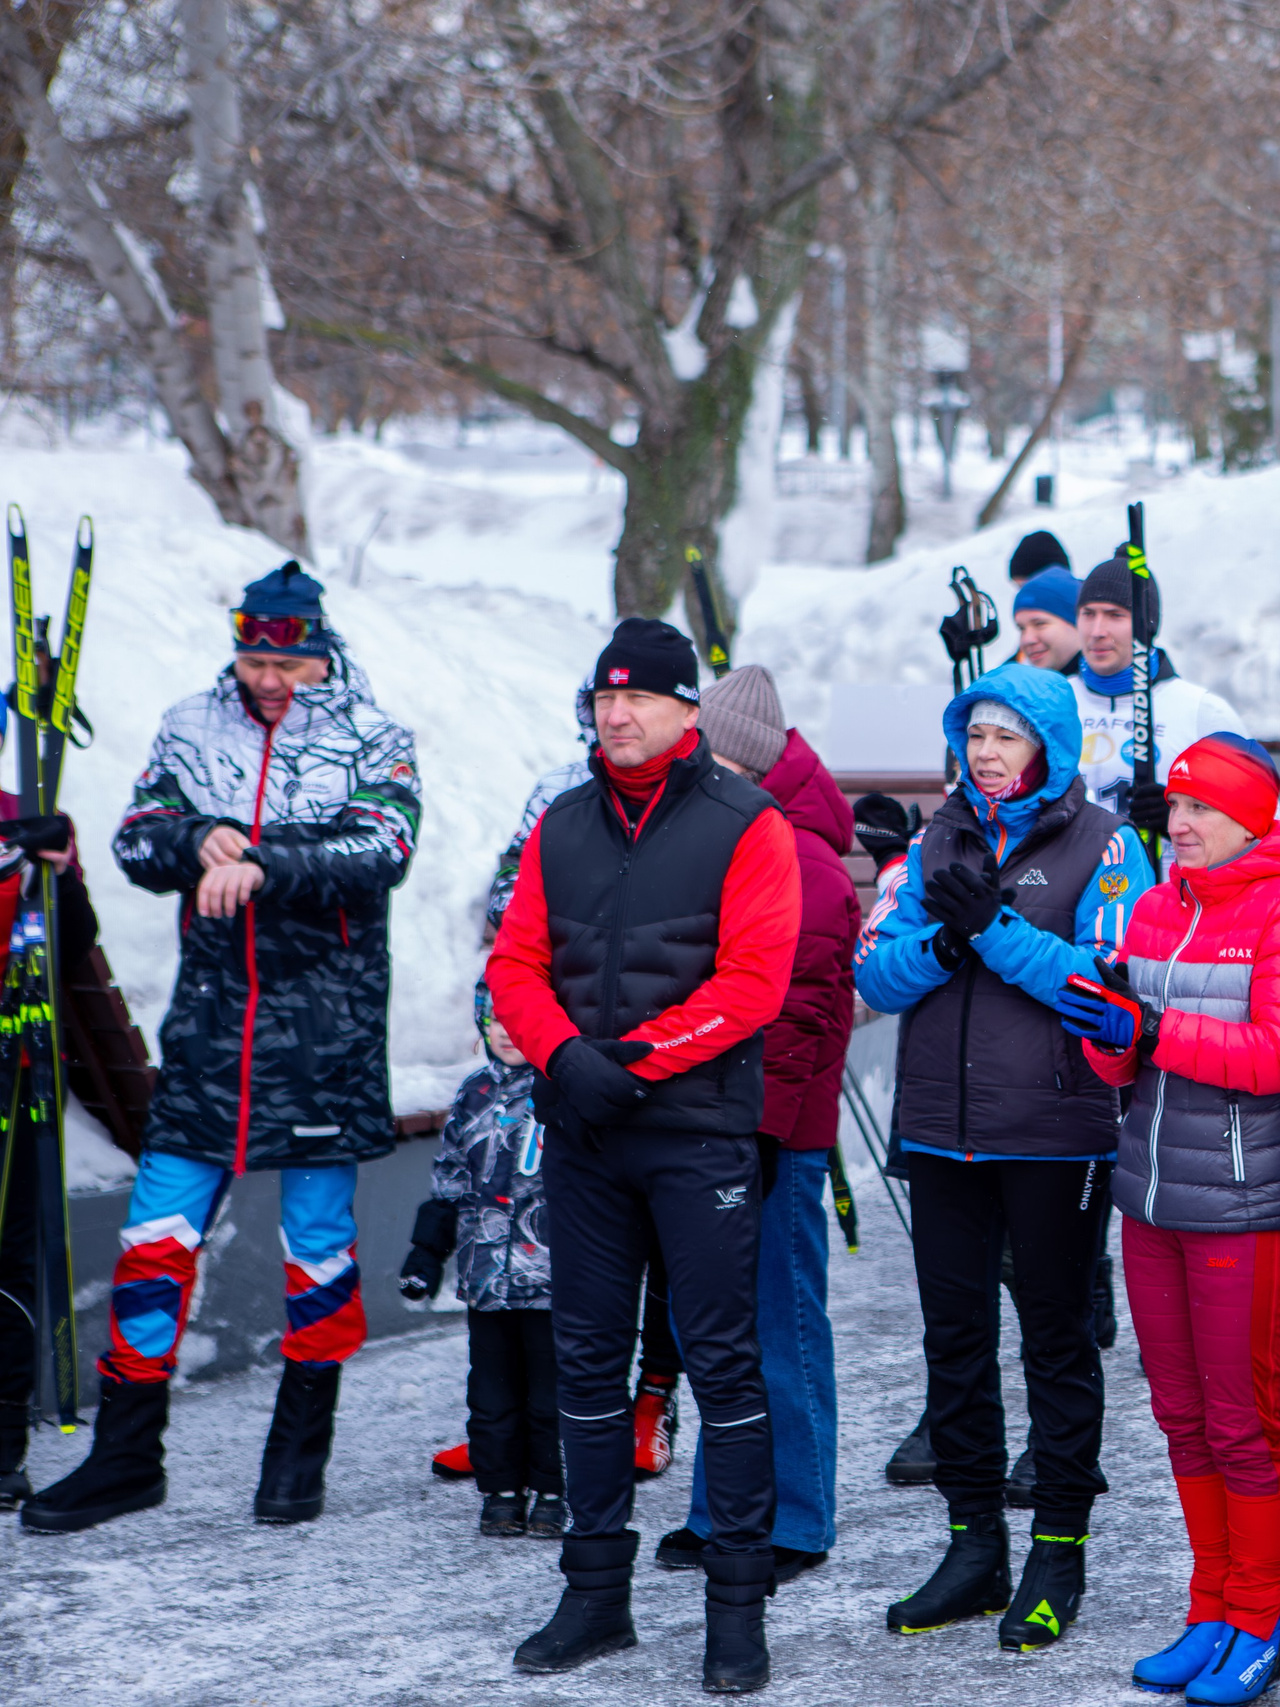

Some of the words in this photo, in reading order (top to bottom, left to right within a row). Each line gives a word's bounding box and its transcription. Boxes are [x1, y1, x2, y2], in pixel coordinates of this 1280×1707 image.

[13, 556, 38, 720] FISCHER
[51, 567, 91, 733] FISCHER
[1133, 639, 1149, 762] NORDWAY
[1219, 947, 1252, 958] MOAX
[694, 1014, 725, 1037] CODE
[1238, 1645, 1276, 1685] SPINE
